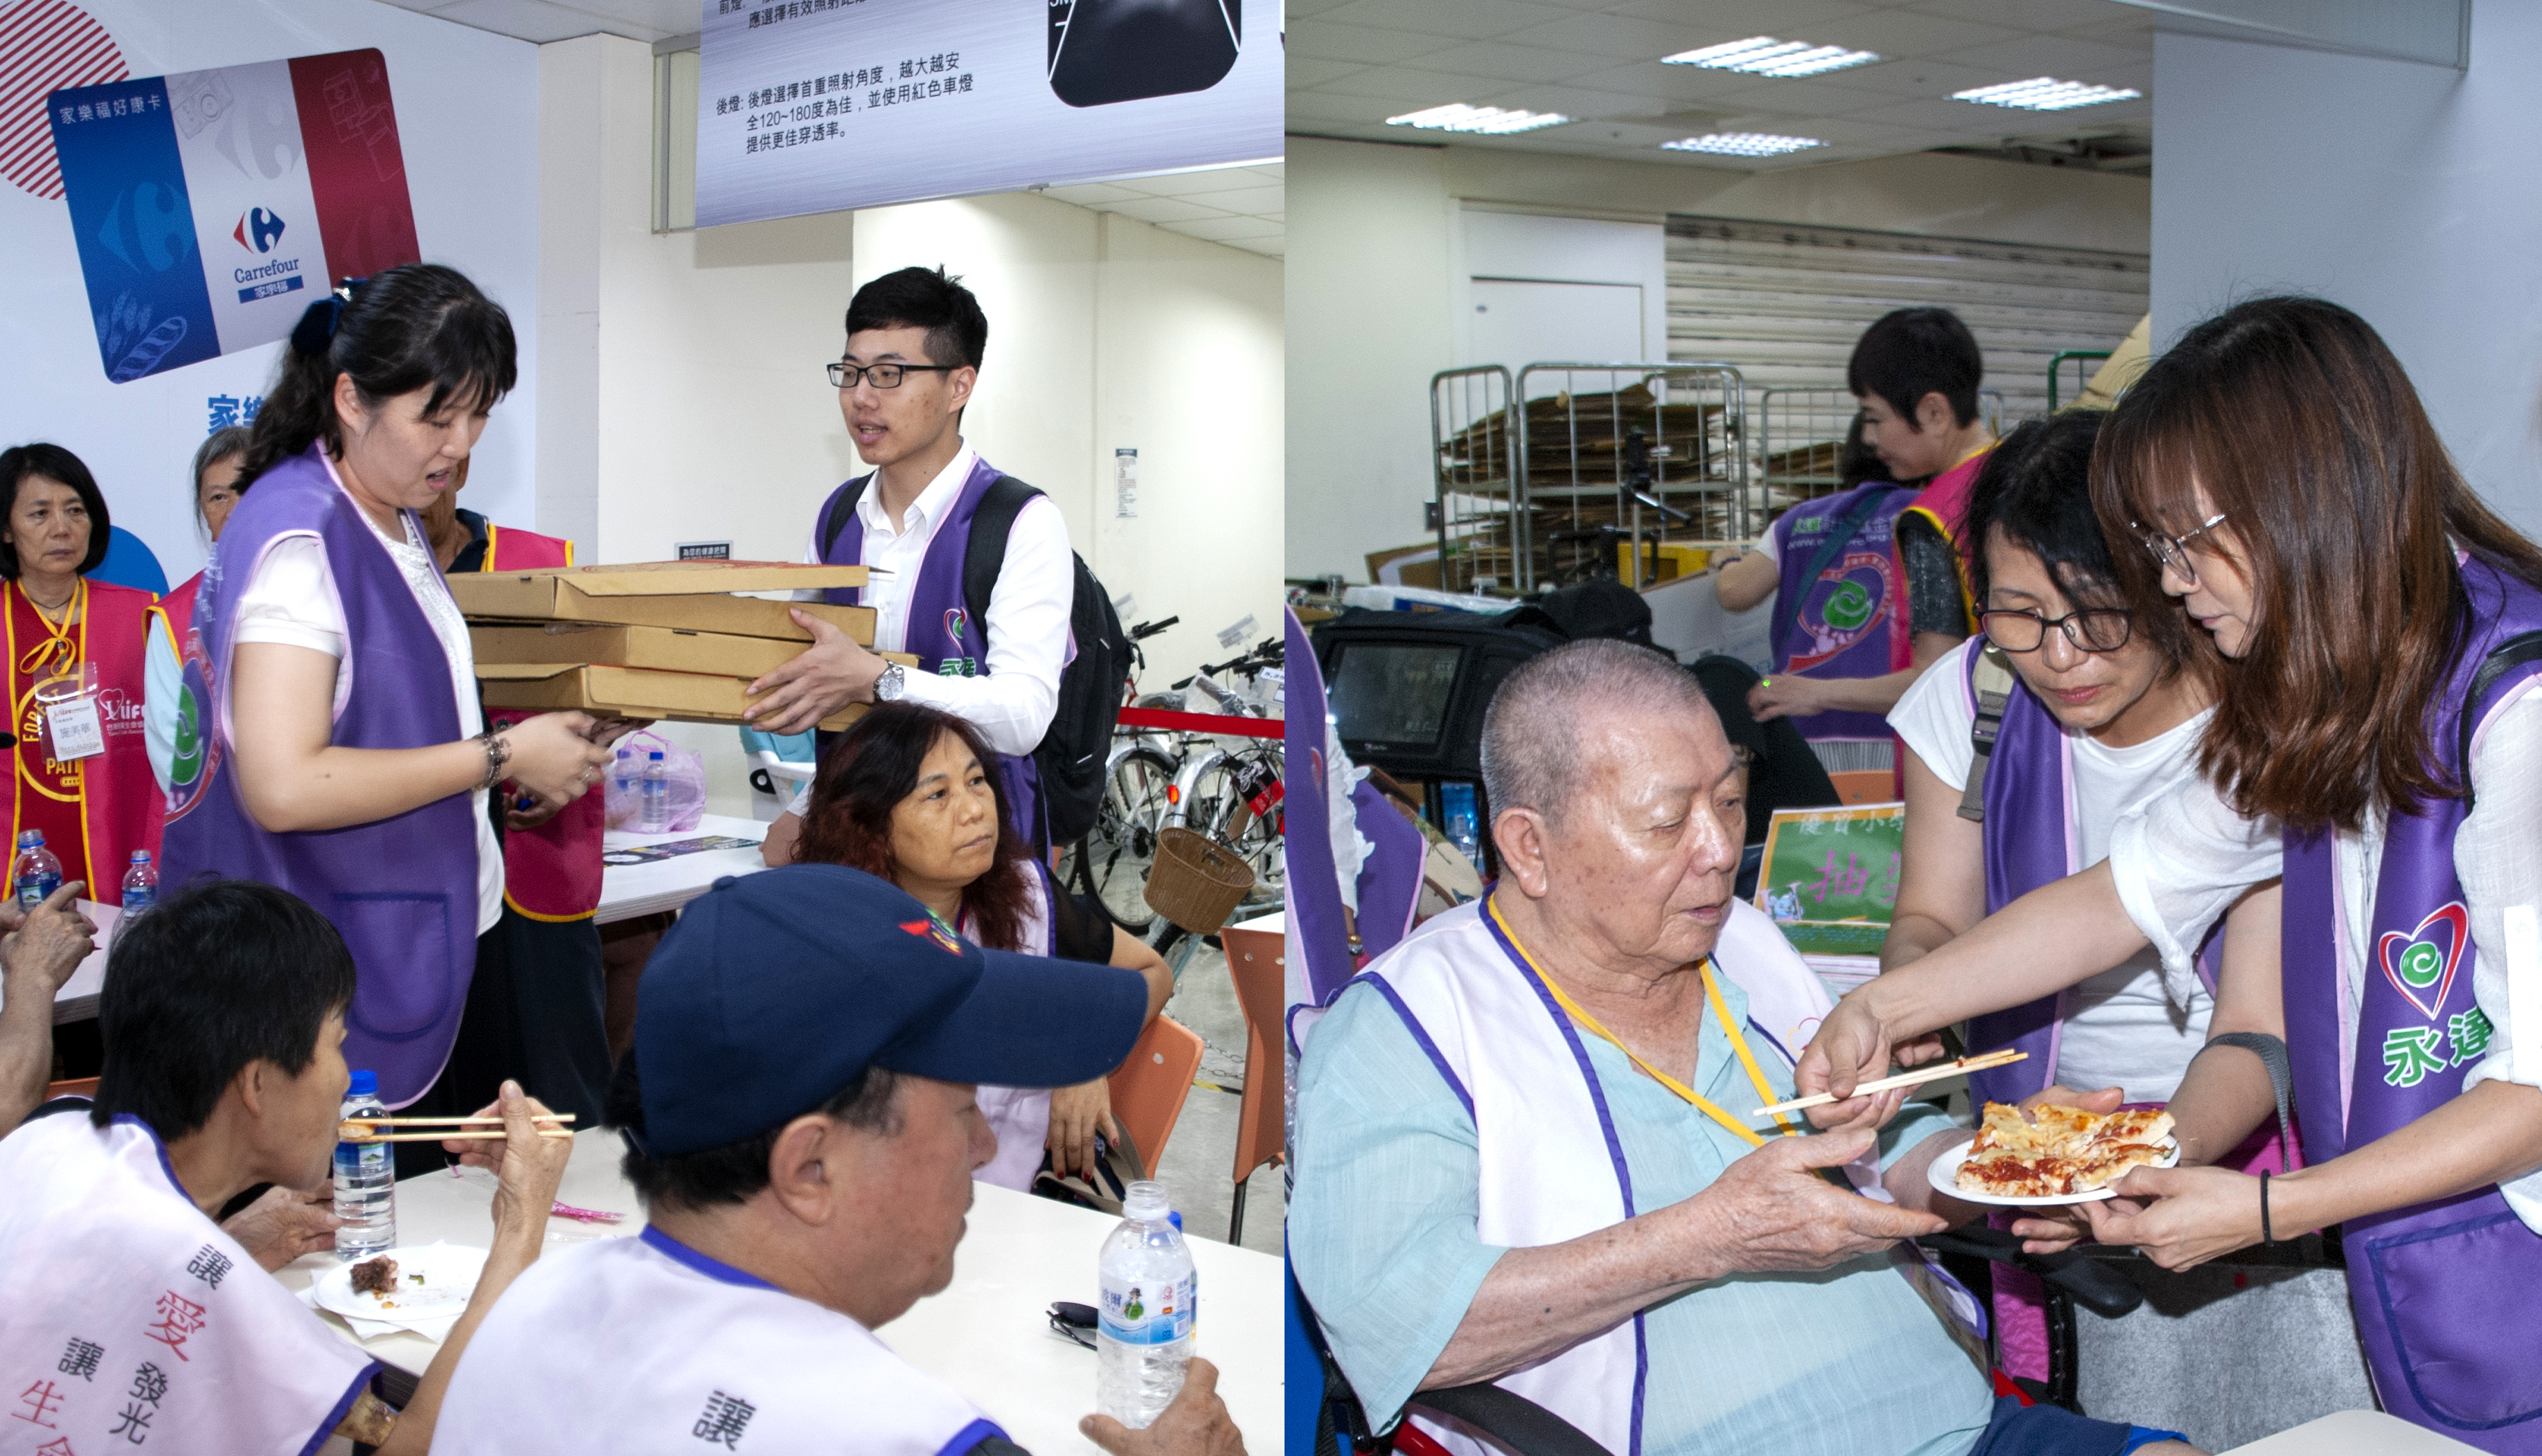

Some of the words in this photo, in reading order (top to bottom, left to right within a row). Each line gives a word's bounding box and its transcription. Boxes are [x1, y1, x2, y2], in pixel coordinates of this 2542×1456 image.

[749, 0, 867, 29] 應選擇有效照射
[60, 94, 161, 125] 家樂福好康卡
[234, 258, 299, 284] Carrefour
[2383, 1004, 2495, 1088] 永達
[691, 1389, 757, 1451] 讓
